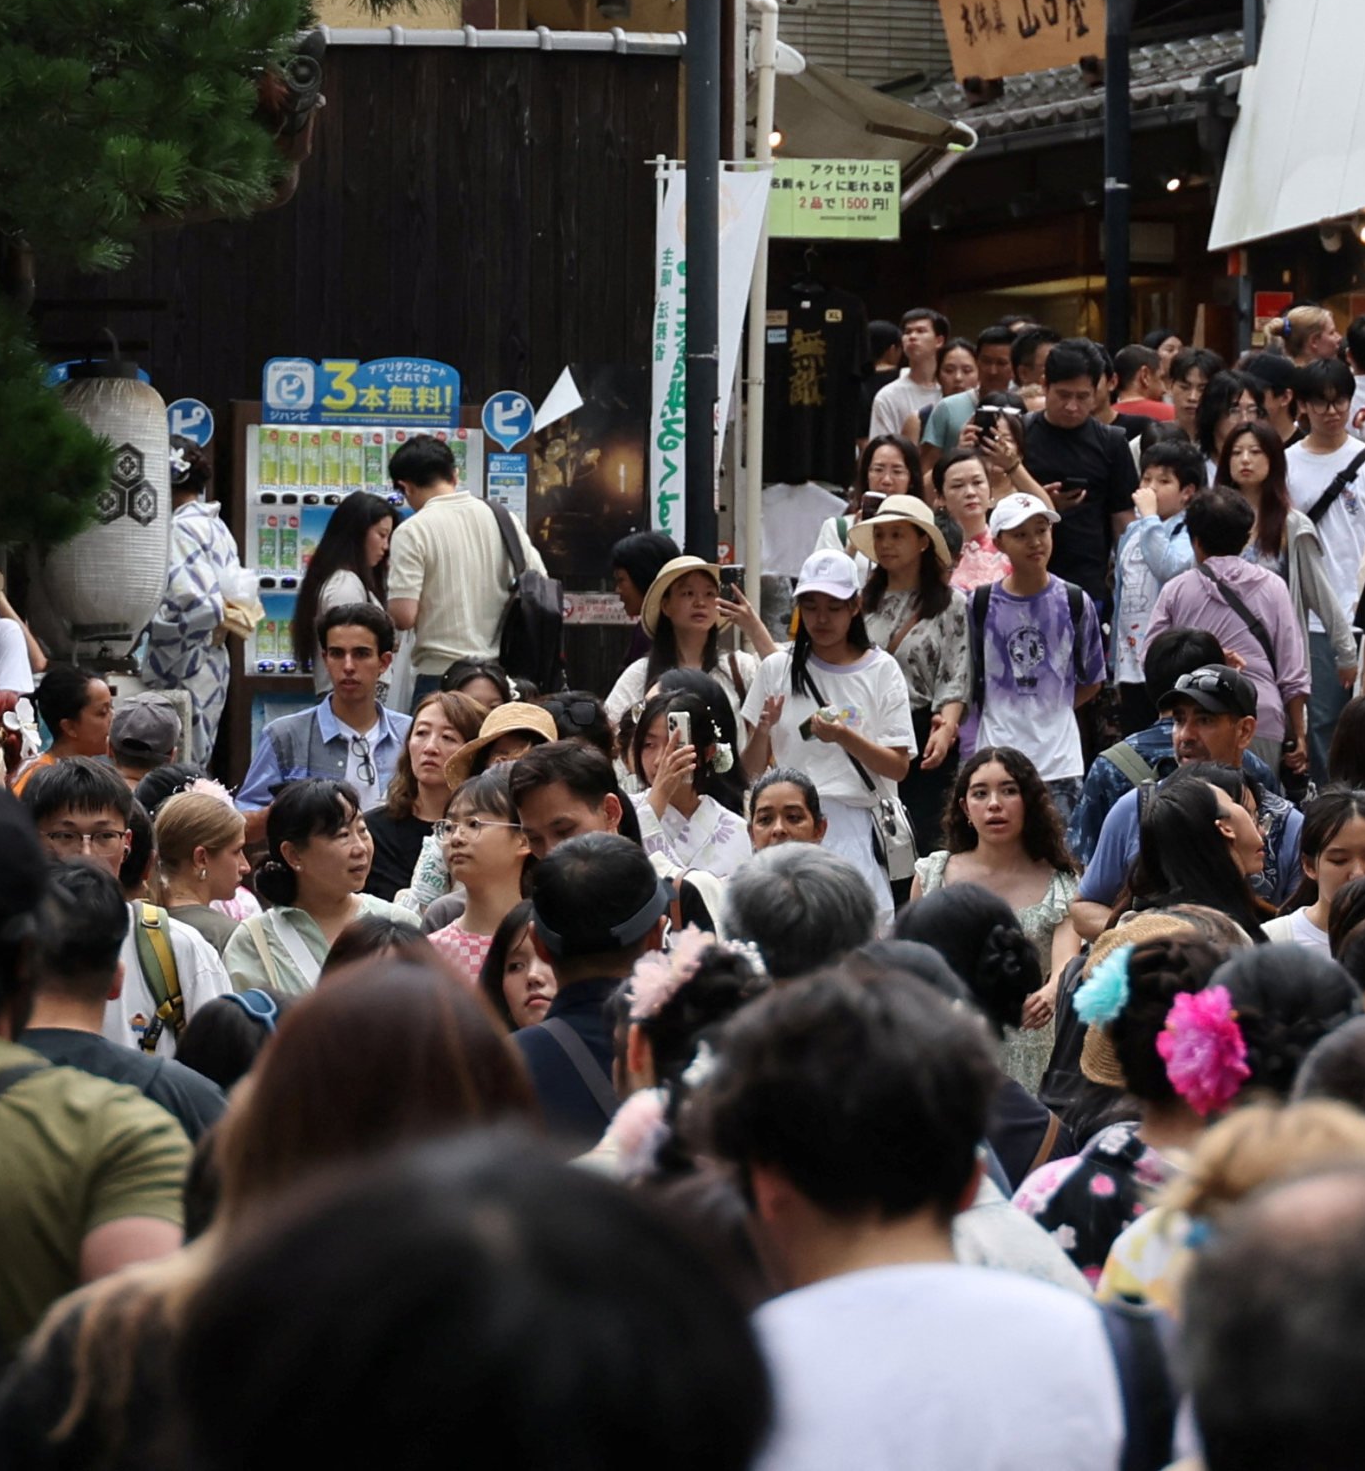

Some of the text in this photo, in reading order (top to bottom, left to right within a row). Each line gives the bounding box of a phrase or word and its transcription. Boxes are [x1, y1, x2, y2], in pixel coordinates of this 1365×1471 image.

[811, 163, 895, 176] アクセサリーに
[368, 361, 448, 378] アプリダウンロード
[385, 373, 432, 384] でどれでも
[493, 397, 525, 437] ピ
